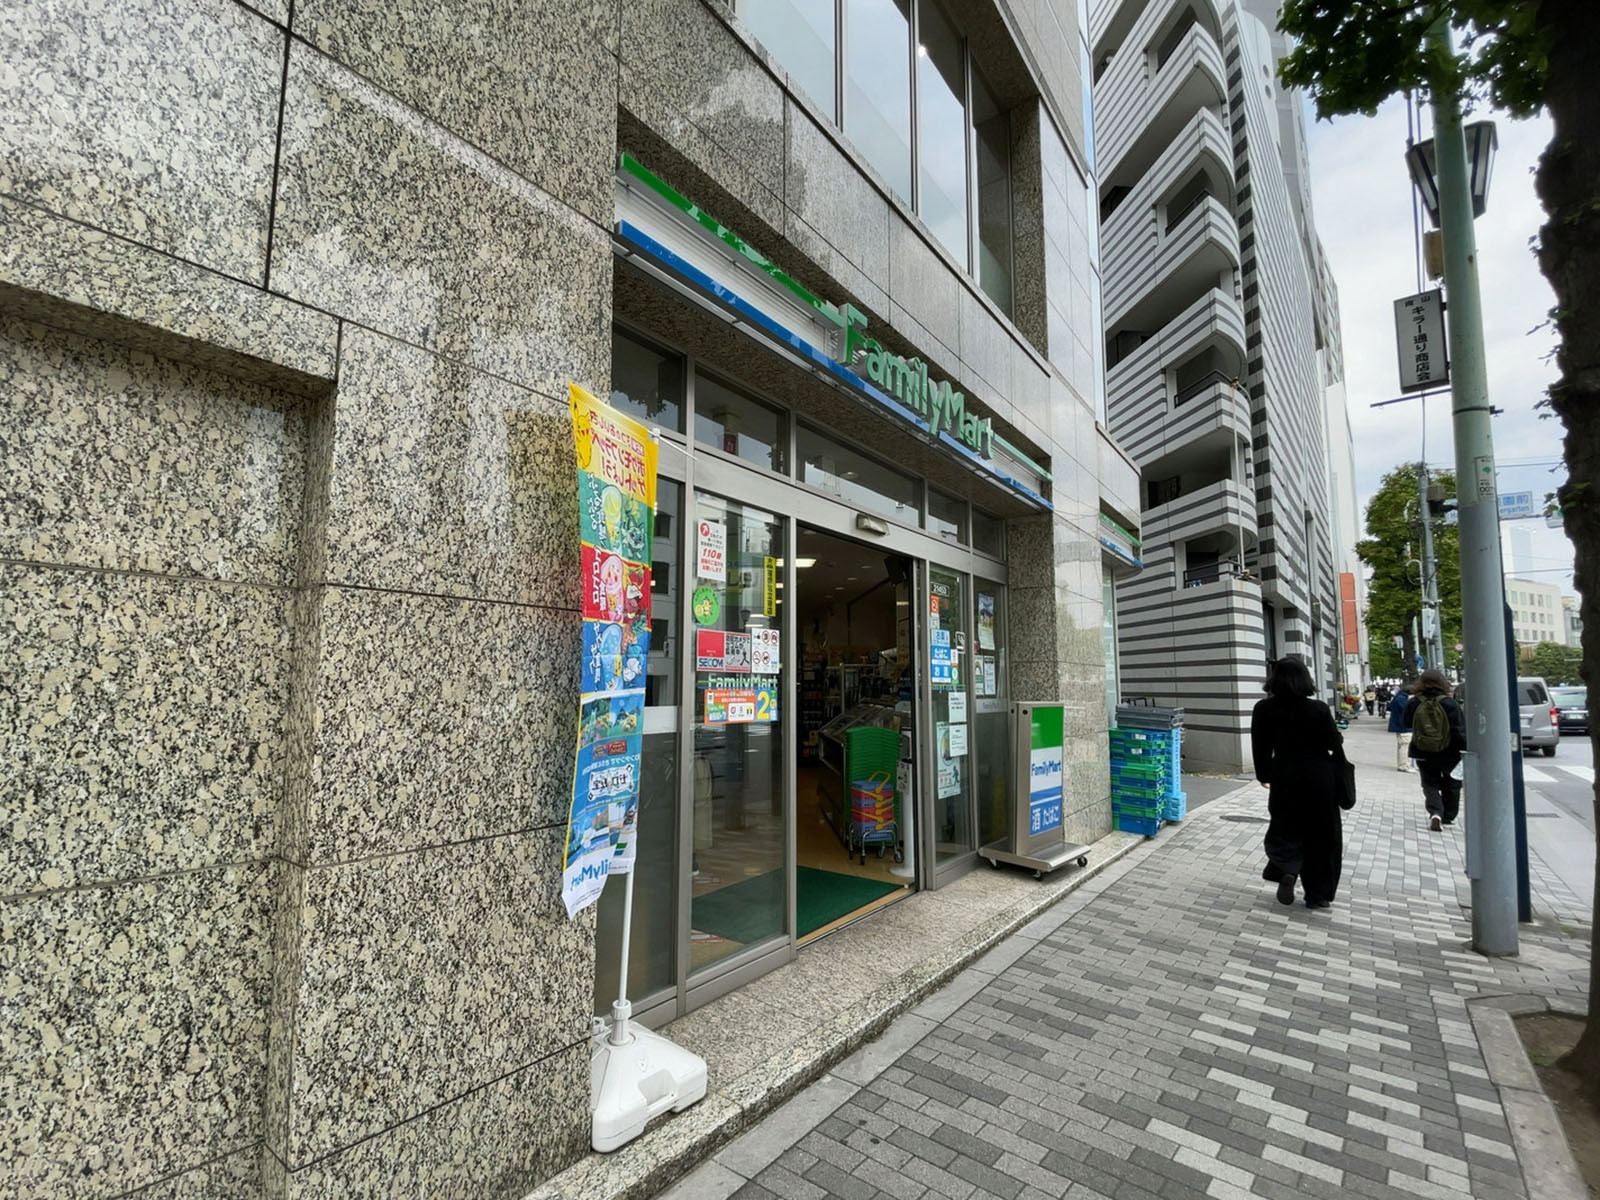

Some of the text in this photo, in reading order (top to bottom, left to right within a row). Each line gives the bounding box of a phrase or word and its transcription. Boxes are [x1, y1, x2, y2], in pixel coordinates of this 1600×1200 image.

[1411, 306, 1431, 382] キラー通り商店会
[838, 303, 994, 460] FamilyMart
[1500, 506, 1530, 515] ergarten
[698, 658, 724, 668] SECOM
[708, 673, 778, 691] FamilyMart
[1031, 760, 1062, 777] FamilyMart
[1043, 805, 1060, 826] たばこ
